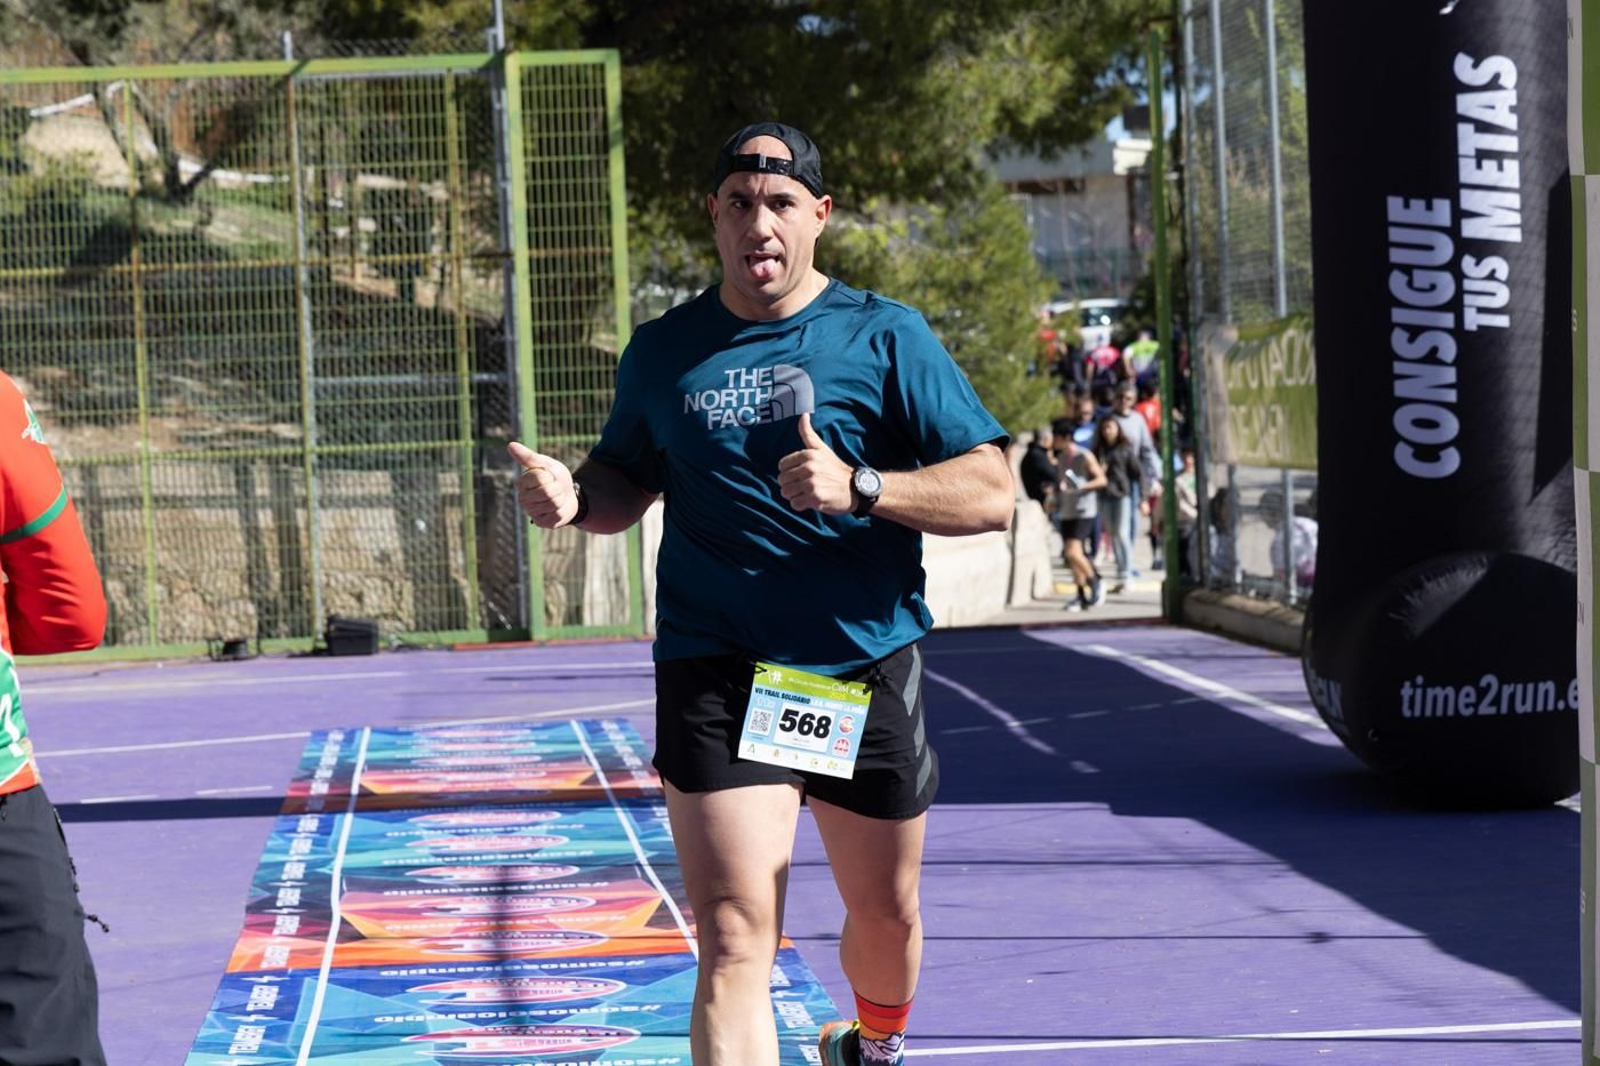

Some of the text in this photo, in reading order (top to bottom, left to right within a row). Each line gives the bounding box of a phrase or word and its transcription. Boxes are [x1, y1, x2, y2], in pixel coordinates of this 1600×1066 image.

[1453, 51, 1522, 331] TUS METAS
[1386, 195, 1462, 479] CONSIGUE
[725, 366, 773, 388] THE
[684, 387, 773, 414] NORTH
[707, 401, 773, 431] FACE
[764, 689, 781, 699] TRAIL
[781, 692, 811, 705] SOLIDARIO
[778, 708, 832, 740] 568
